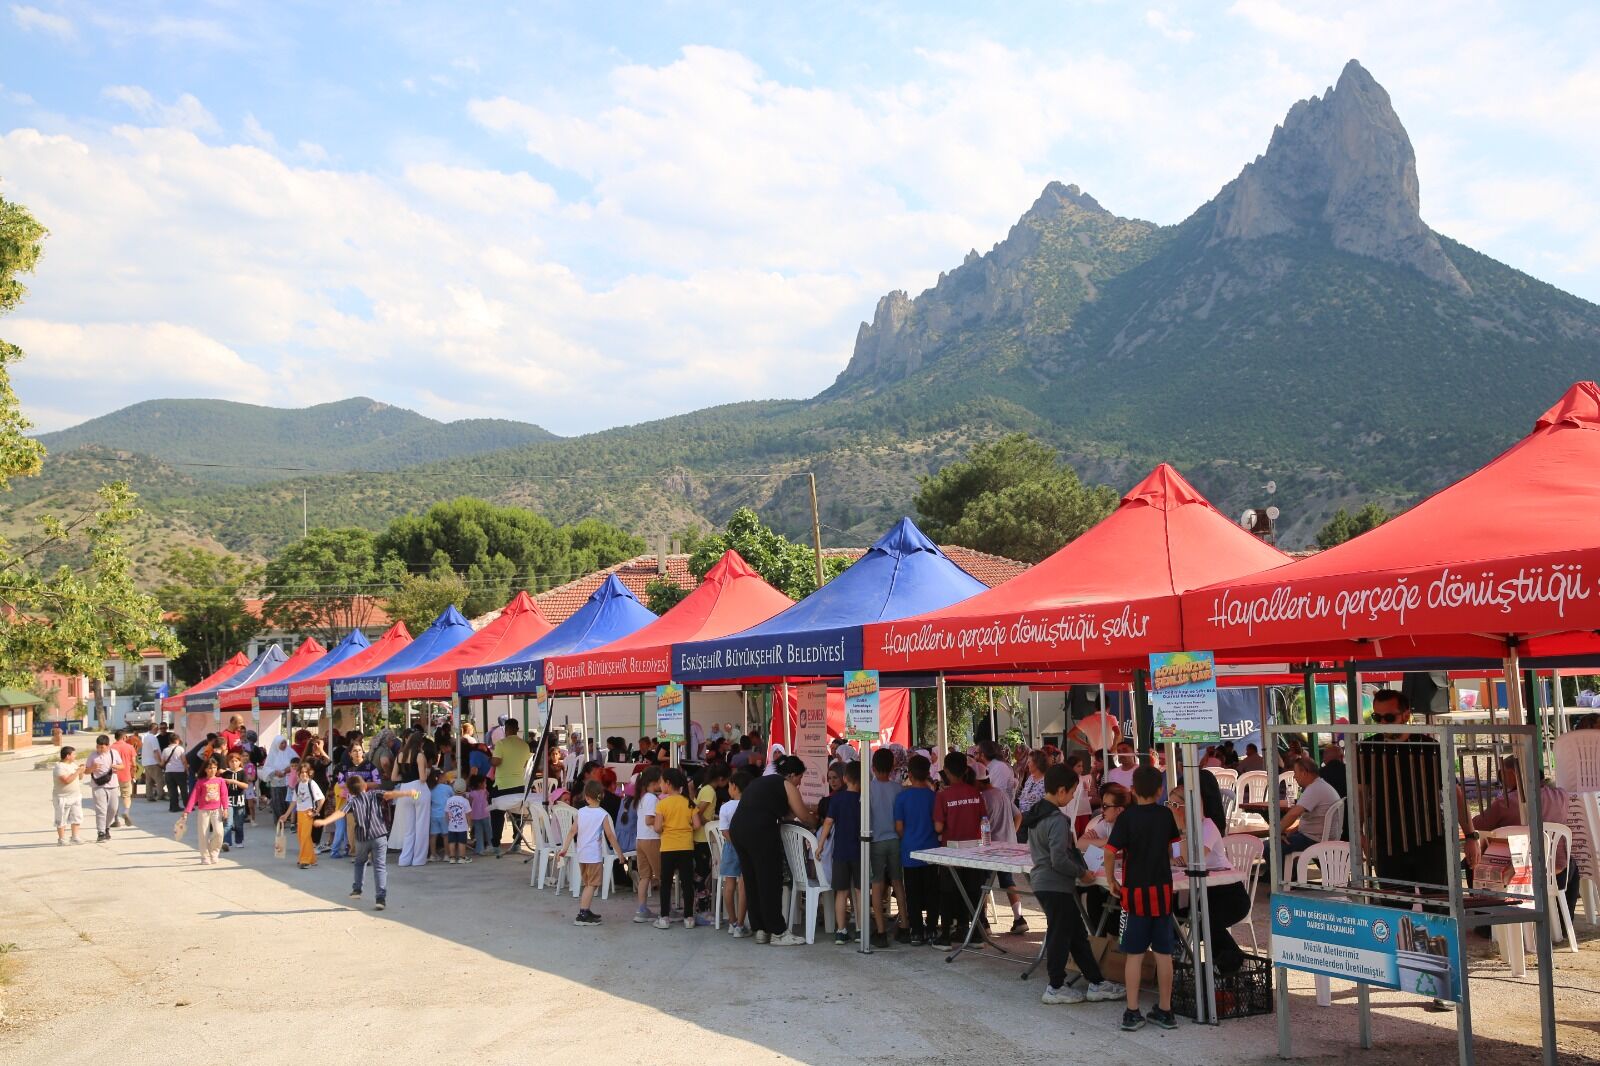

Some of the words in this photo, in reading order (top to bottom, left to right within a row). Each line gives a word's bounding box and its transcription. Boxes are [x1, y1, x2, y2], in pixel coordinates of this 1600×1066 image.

[1207, 586, 1331, 636] Hayallerin
[1335, 578, 1421, 630] gerçeğe
[1427, 564, 1590, 617] dönüştüğü
[881, 624, 955, 663] Hayallerin
[957, 620, 1008, 659] gerçeğe
[1010, 614, 1099, 651] dönüştüğü
[1101, 604, 1150, 646] şehir
[1220, 720, 1254, 738] EHİR
[227, 795, 245, 807] ELAX
[1303, 941, 1322, 953] Müzik
[1323, 945, 1360, 960] Aletlerimiz
[1281, 950, 1294, 961] Atık
[1295, 953, 1344, 970] Malzemelerden
[1344, 959, 1386, 978] Üretilmiştir.
